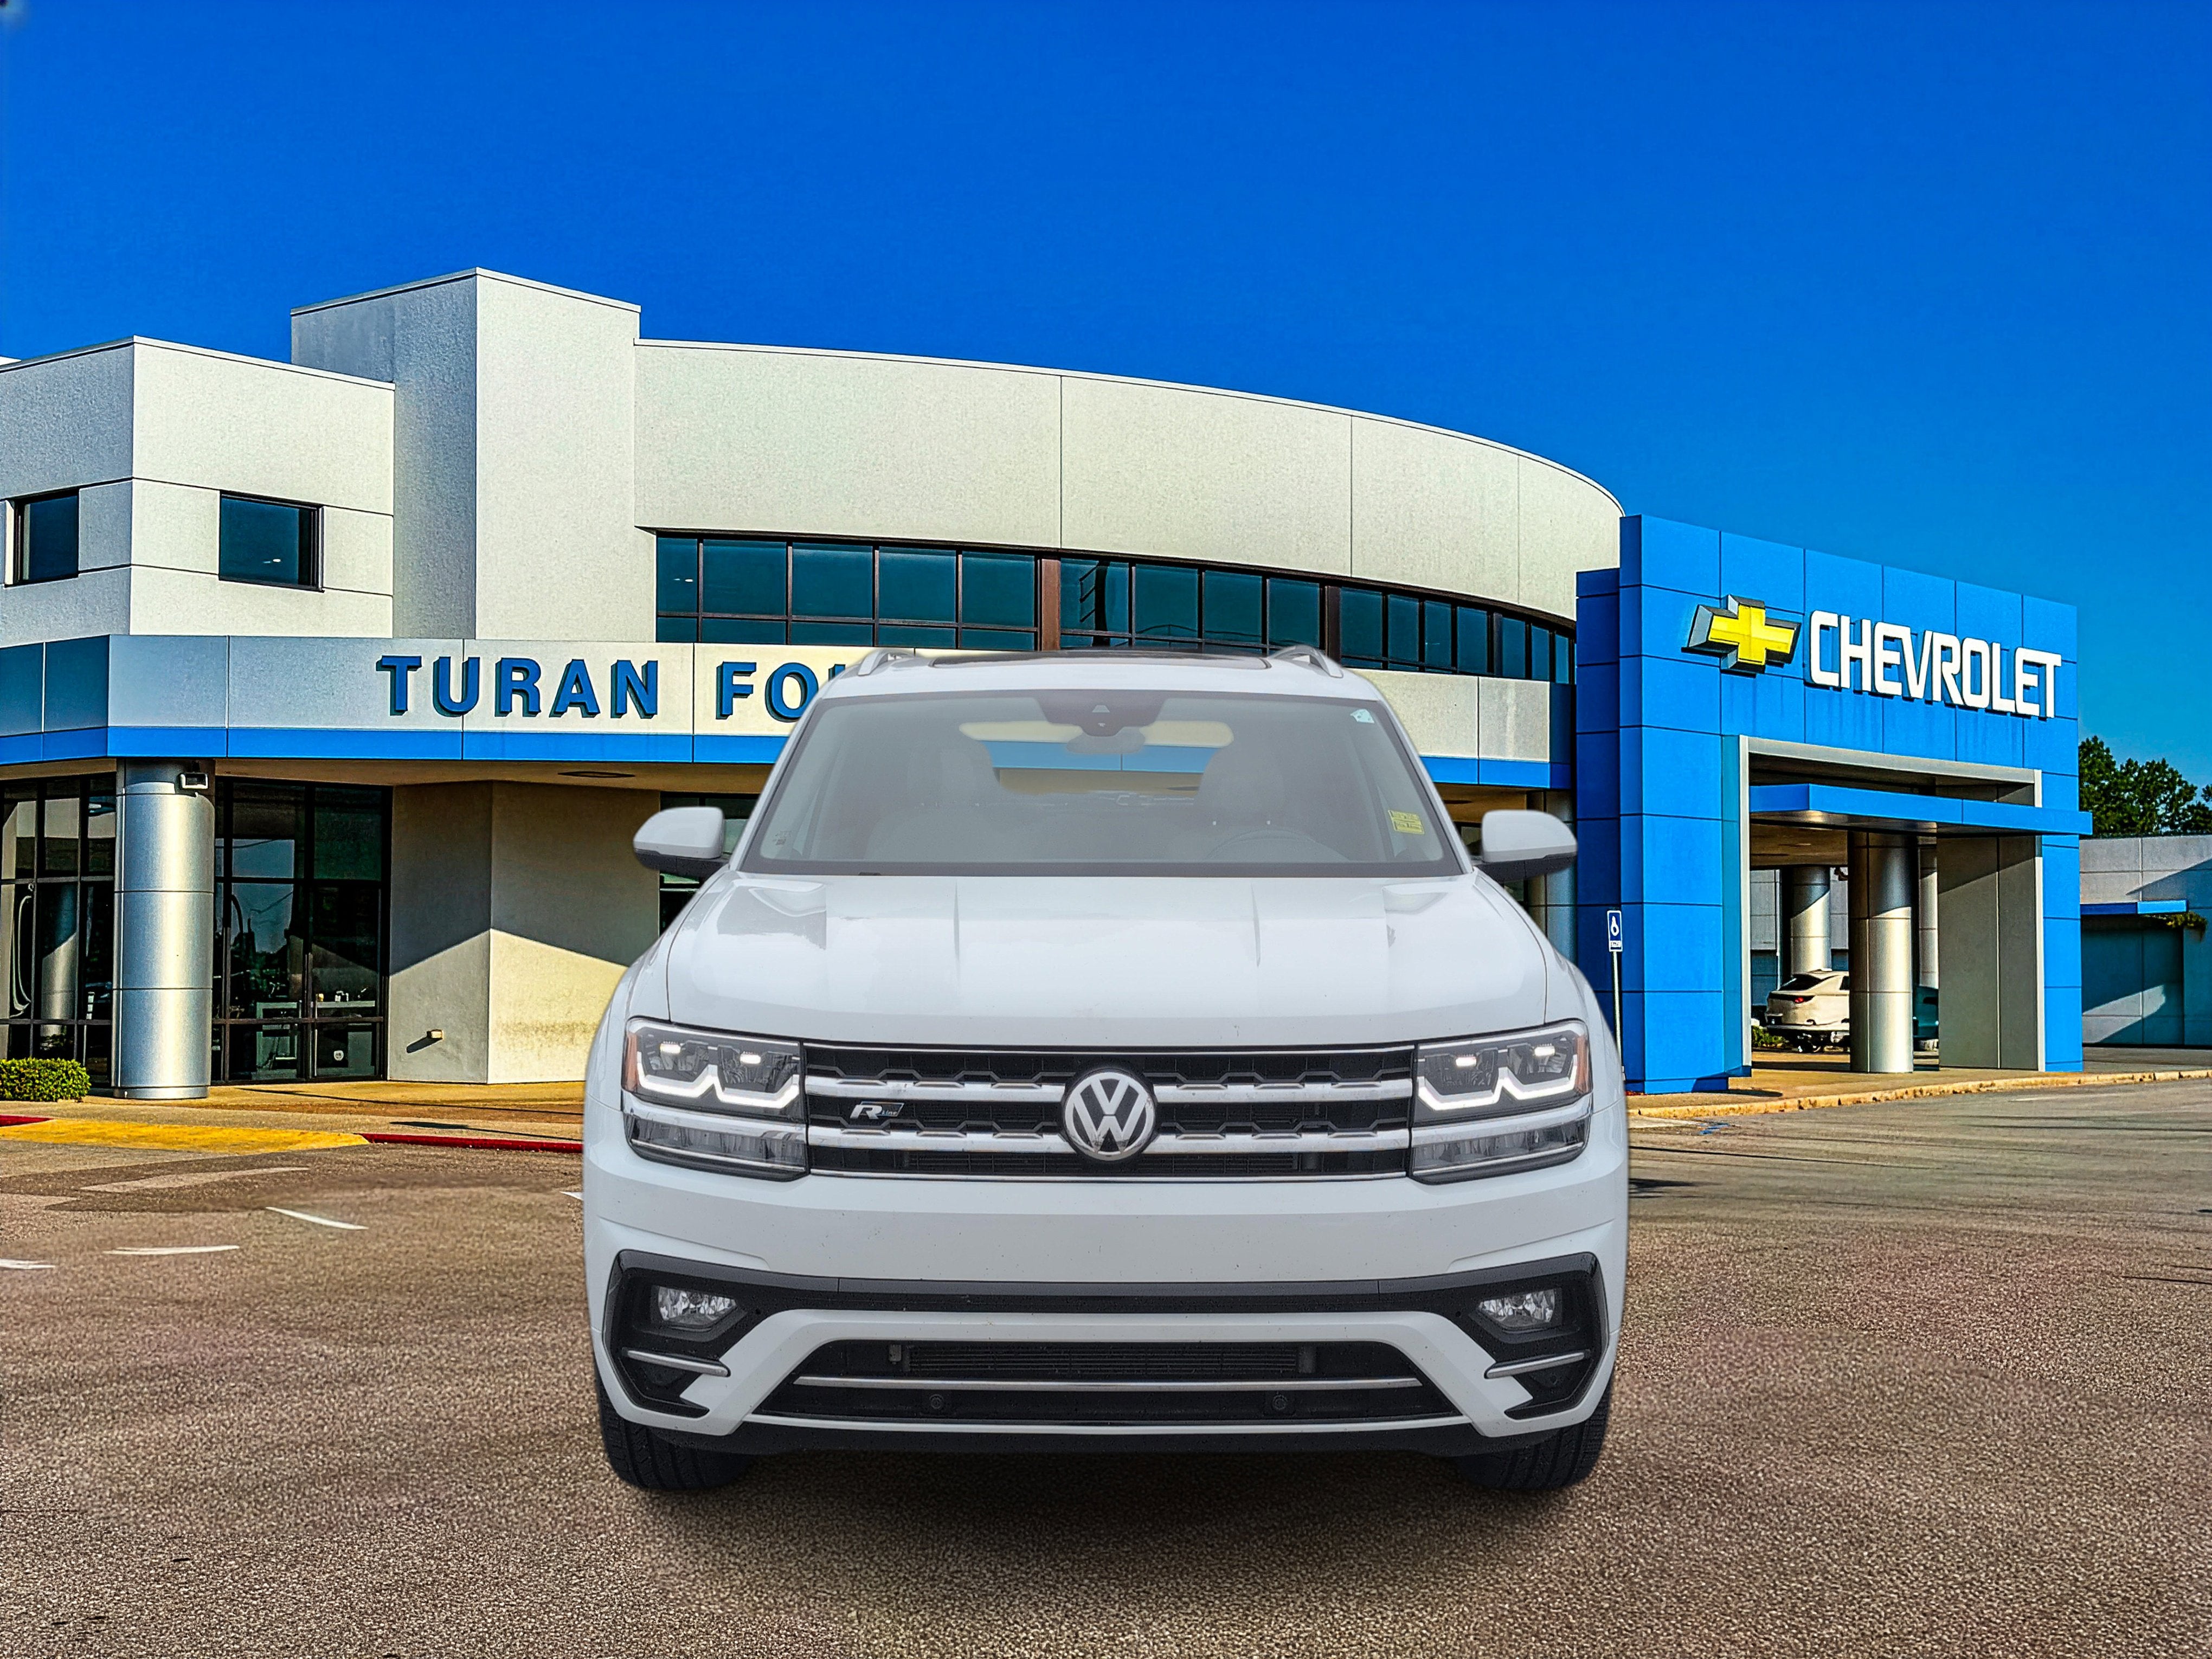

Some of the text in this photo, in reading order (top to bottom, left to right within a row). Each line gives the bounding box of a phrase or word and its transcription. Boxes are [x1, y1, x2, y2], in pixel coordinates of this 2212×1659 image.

[376, 655, 846, 723] TURAN FO
[1810, 610, 2062, 718] CHEVROLET
[1067, 1073, 1153, 1159] VW
